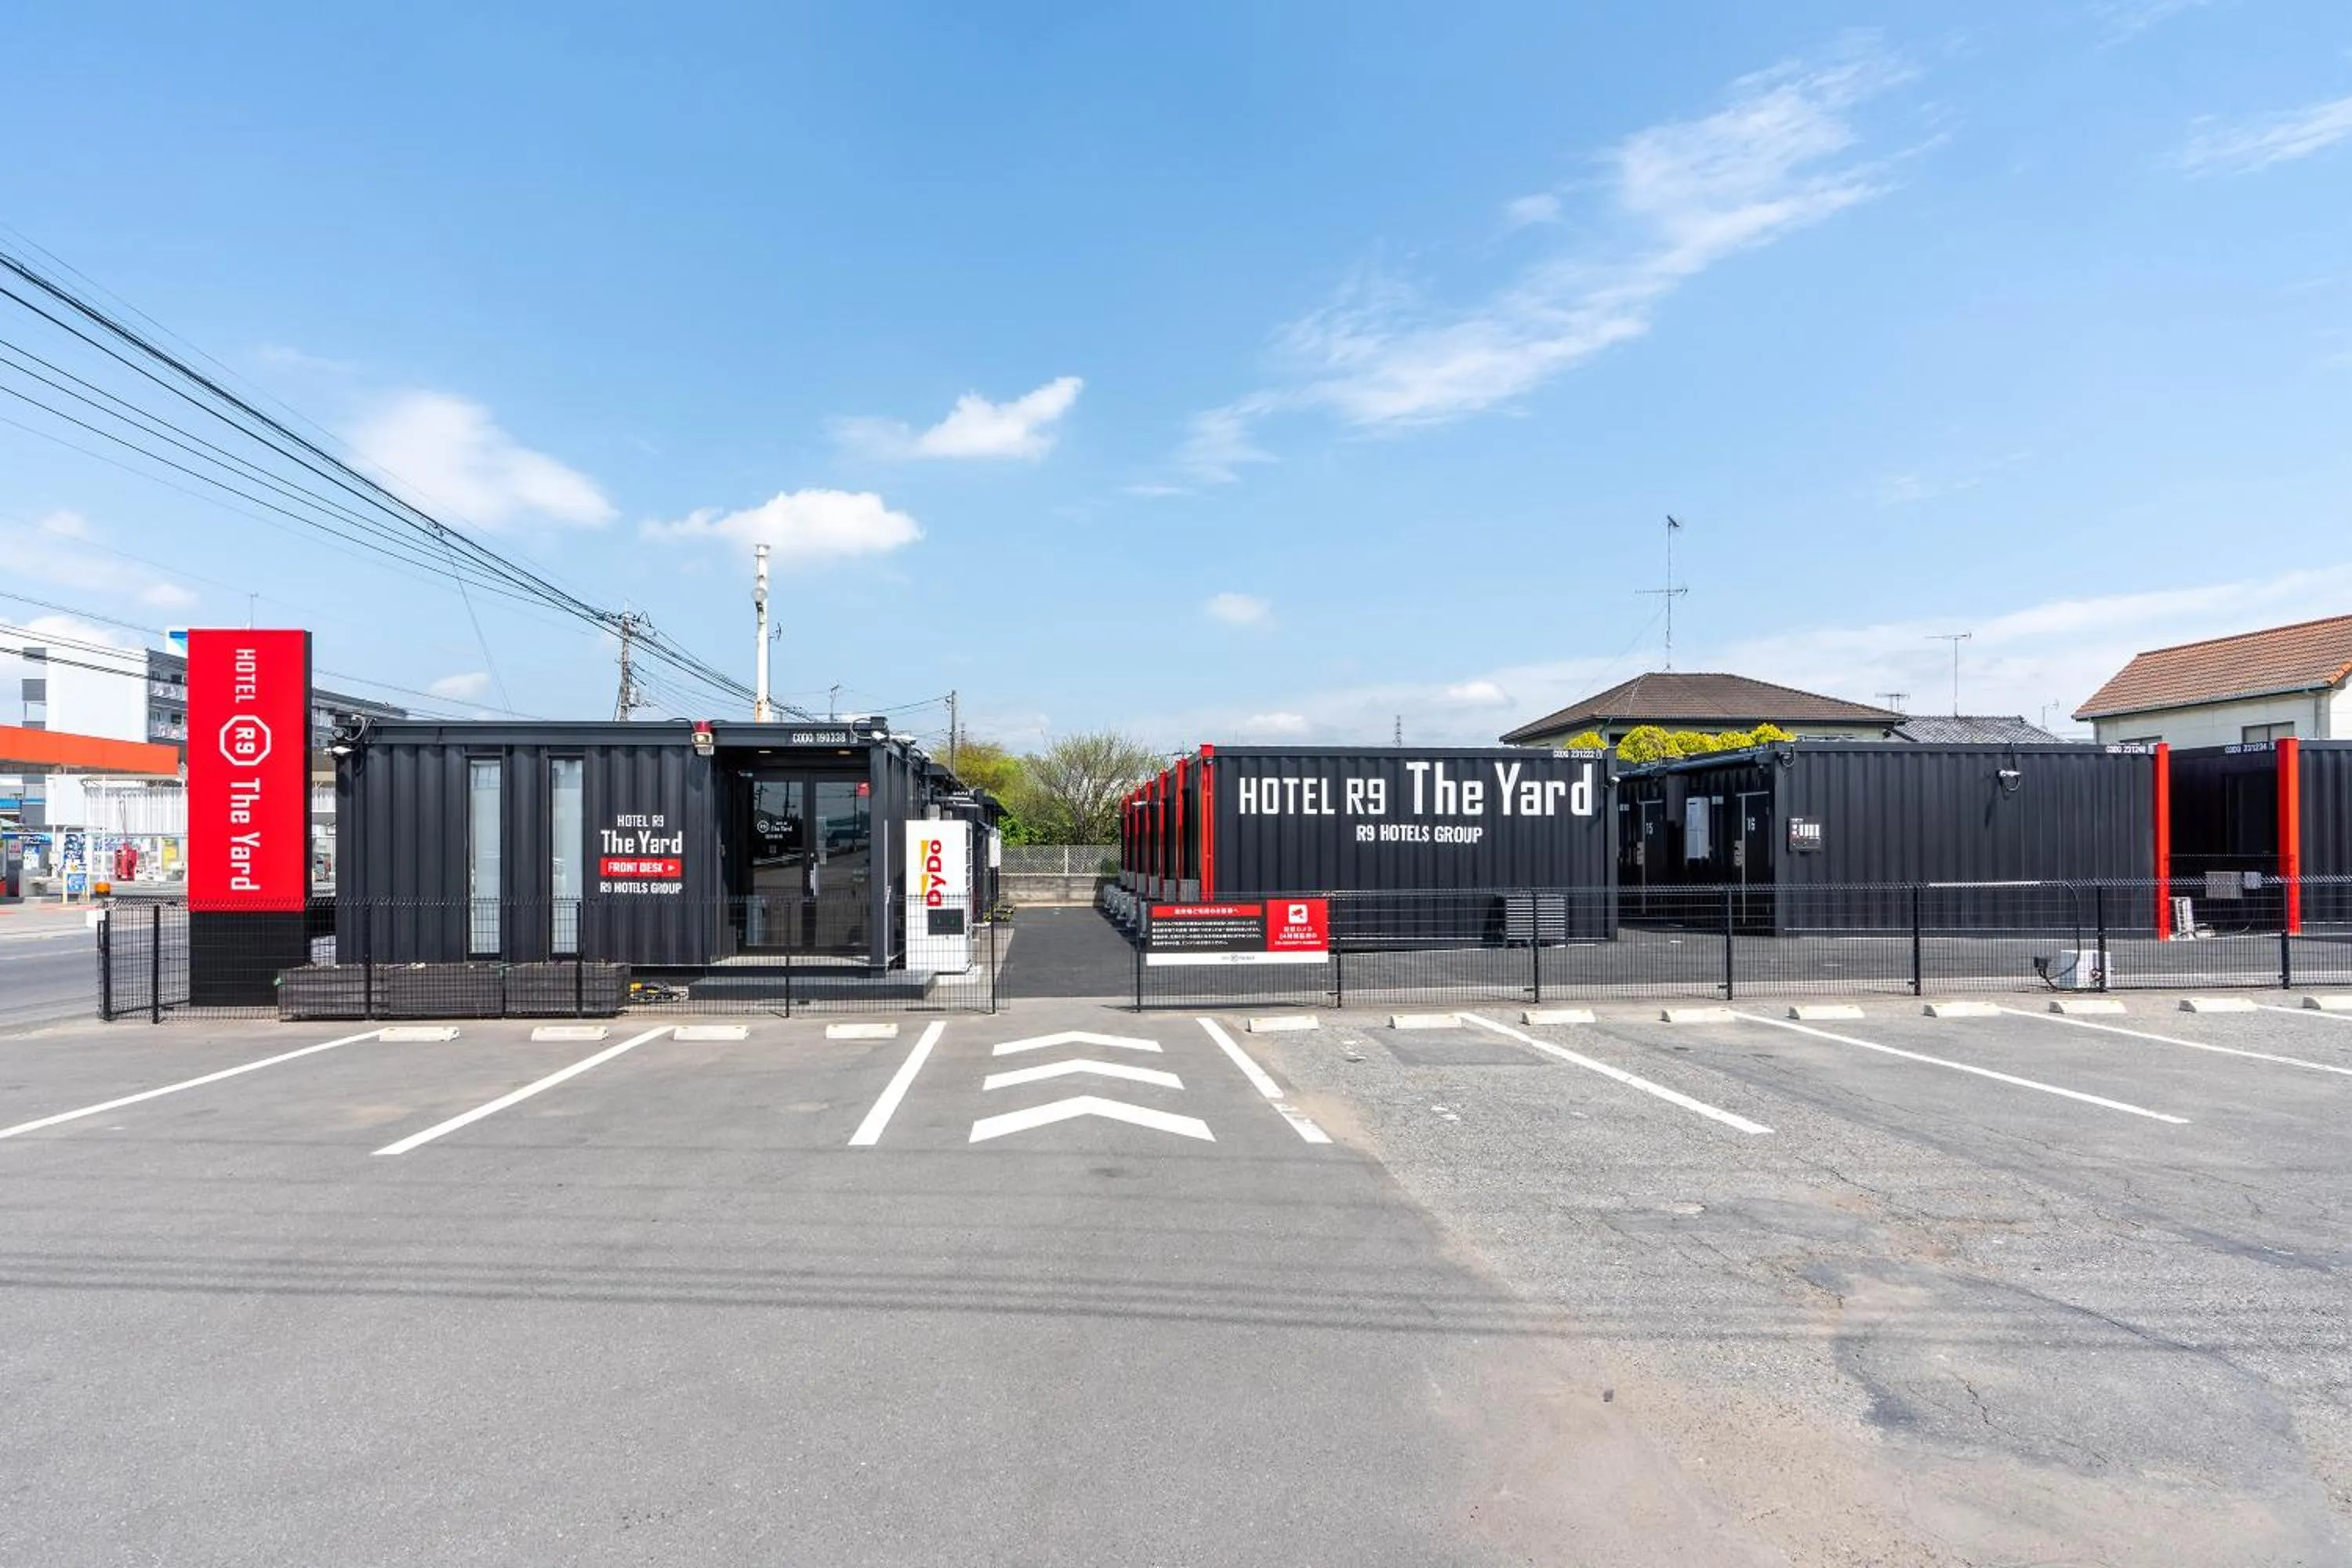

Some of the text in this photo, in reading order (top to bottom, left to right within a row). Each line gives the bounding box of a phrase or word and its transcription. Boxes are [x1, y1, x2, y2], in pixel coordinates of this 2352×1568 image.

[235, 648, 256, 702] HOTEL
[235, 727, 256, 753] R9
[1239, 761, 1592, 816] HOTEL R9 The Yard
[617, 815, 664, 827] HOTEL R9
[230, 778, 260, 890] The Yard
[600, 829, 683, 854] The Yard
[1356, 825, 1483, 844] R9 HOTELS GROUP
[608, 862, 664, 873] FRONT DESK
[927, 840, 946, 906] DyDo
[600, 881, 683, 894] R9 HOTELS GROUP
